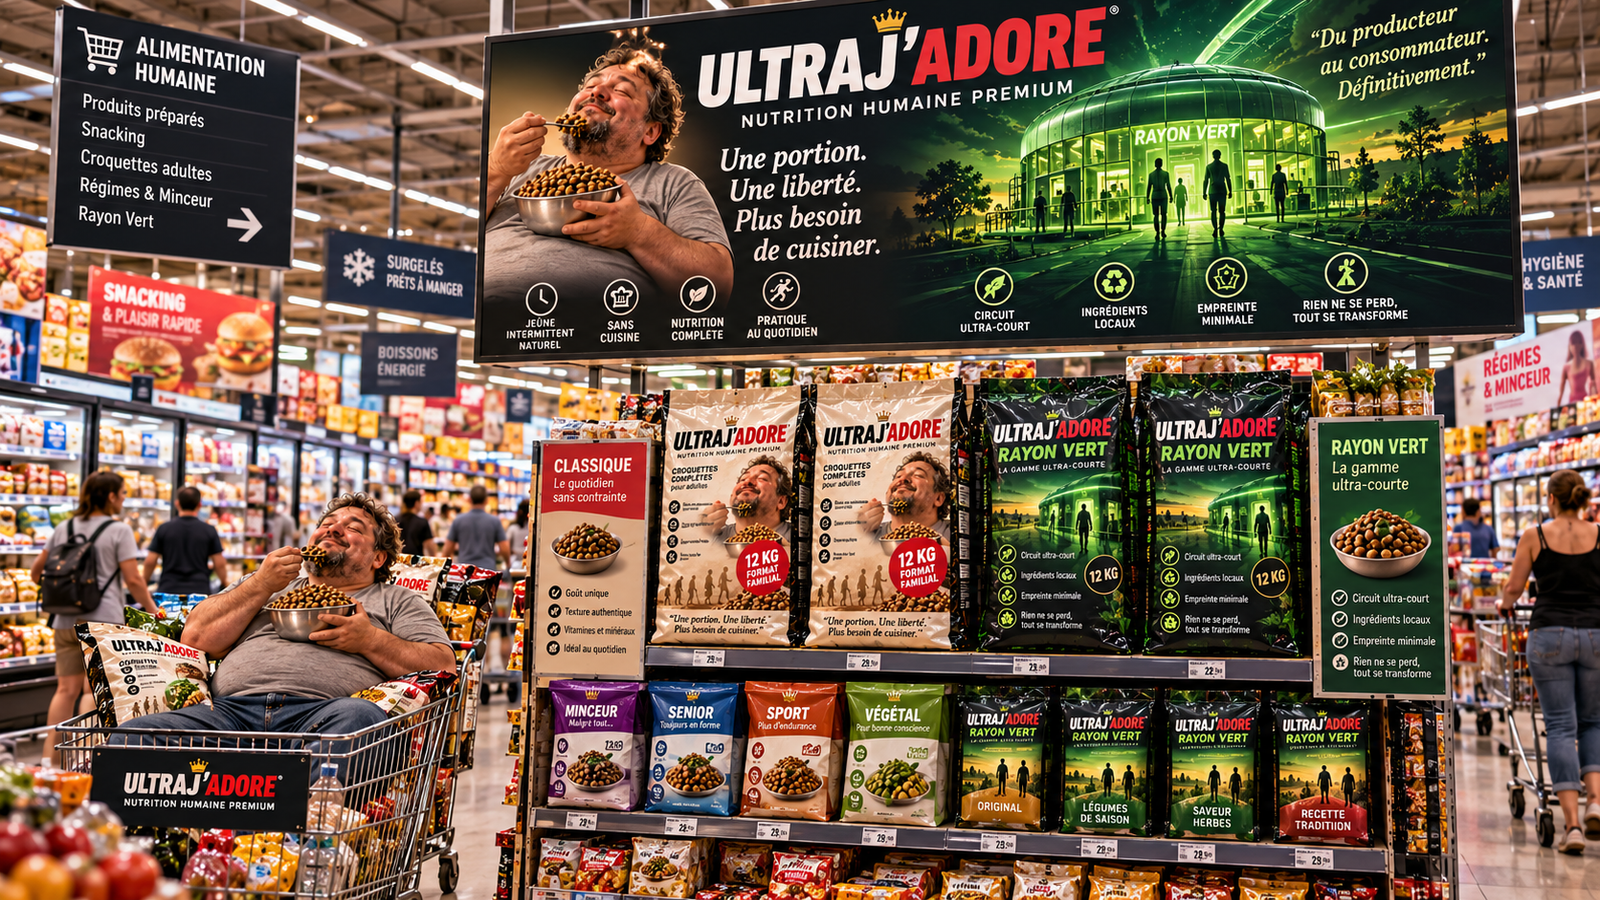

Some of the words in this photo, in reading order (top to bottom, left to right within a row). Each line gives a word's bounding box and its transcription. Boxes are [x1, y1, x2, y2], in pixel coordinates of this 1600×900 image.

[1351, 6, 1458, 48] producteur
[136, 36, 266, 78] ALIMENTATION
[1320, 58, 1343, 76] au
[1348, 29, 1489, 70] consommateur.
[135, 62, 217, 94] HUMAINE
[82, 93, 141, 117] Produits
[145, 106, 205, 128] préparés
[741, 104, 853, 129] NUTRITION
[863, 91, 961, 116] HUMAINE
[972, 80, 1074, 105] PREMIUM
[81, 121, 146, 148] Snacking
[1134, 124, 1190, 146] RAYON
[1195, 123, 1240, 139] VERT
[720, 147, 767, 172] Une
[772, 139, 867, 174] portion.
[80, 149, 159, 174] Croquettes
[162, 162, 213, 182] adultes
[730, 178, 776, 202] Une
[782, 169, 862, 198] liberté.
[80, 177, 140, 199] Régimes
[144, 185, 155, 200] &
[159, 186, 214, 209] Minceur
[78, 205, 122, 226] Rayon
[126, 210, 154, 229] Vert
[734, 207, 783, 232] Plus
[789, 201, 862, 228] besoin
[754, 238, 780, 262] de
[786, 233, 880, 260] cuisiner.
[386, 254, 444, 276] SURGELÉS
[1522, 252, 1585, 272] HYGIÈNE
[1522, 276, 1534, 290] &
[1537, 270, 1584, 290] SANTÉ
[426, 280, 463, 298] MANGER
[104, 282, 186, 313] SNACKING
[1302, 300, 1328, 310] RIEN
[1330, 299, 1346, 309] NE
[1348, 298, 1362, 308] SE
[1366, 298, 1398, 309] PERD,
[974, 310, 1015, 320] CIRCUIT
[1081, 304, 1148, 317] INGRÉDIENTS
[1197, 302, 1258, 314] EMPREINTE
[102, 306, 113, 322] &
[114, 307, 160, 329] PLAISIR
[162, 314, 203, 335] RAPIDE
[525, 316, 556, 328] JEÛNE
[671, 316, 724, 328] NUTRITION
[757, 314, 807, 326] PRATIQUE
[1202, 314, 1254, 326] MINIMALE
[1292, 312, 1320, 323] TOUT
[1322, 312, 1336, 322] SE
[1338, 309, 1409, 322] TRANSFORME
[607, 320, 634, 330] SANS
[960, 321, 1030, 333] ULTRA-COURT
[1094, 318, 1136, 330] LOCAUX
[506, 328, 575, 339] INTERMITTENT
[600, 332, 640, 343] CUISINE
[746, 328, 761, 339] AU
[764, 327, 818, 340] QUOTIDIEN
[378, 345, 438, 361] BOISSONS
[518, 340, 562, 352] NATUREL
[1484, 345, 1542, 378] RÉGIMES
[377, 361, 426, 377] ÉNERGIE
[1484, 381, 1492, 398] &
[1494, 366, 1551, 396] MINCEUR
[998, 444, 1058, 462] RAYON
[1062, 441, 1108, 458] VERT
[1160, 444, 1222, 462] RAYON
[1227, 442, 1274, 458] VERT
[1331, 438, 1384, 456] RAYON
[1388, 438, 1429, 454] VERT
[554, 457, 632, 474] CLASSIQUE
[1332, 461, 1347, 474] La
[1351, 462, 1400, 477] gamme
[554, 478, 566, 489] Le
[1332, 478, 1410, 492] ultra-courte
[552, 494, 575, 502] sans
[577, 491, 627, 502] contrainte
[744, 552, 761, 568] 12
[762, 548, 779, 564] KG
[898, 551, 914, 568] 12
[917, 546, 936, 564] KG
[746, 564, 778, 578] FORMAT
[900, 564, 936, 579] FORMAT
[1089, 570, 1103, 584] 12
[1104, 566, 1118, 580] KG
[1256, 572, 1270, 586] 12
[1270, 568, 1286, 584] KG
[746, 574, 781, 588] FAMILIAL
[900, 574, 940, 588] FAMILIAL
[584, 590, 610, 600] unique
[1352, 593, 1380, 603] Circuit
[1382, 593, 1430, 603] ultra-court
[564, 608, 590, 617] Texture
[592, 608, 633, 619] authentique
[1353, 614, 1400, 626] Ingrédients
[1402, 614, 1431, 624] locaux
[564, 625, 596, 636] Vitamines
[597, 626, 604, 636] et
[1353, 635, 1396, 648] Empreinte
[1397, 636, 1436, 646] minimale
[564, 643, 581, 654] Idéal
[582, 646, 592, 654] au
[592, 644, 627, 656] quotidien
[1353, 656, 1372, 666] Rien
[1398, 657, 1420, 669] perd,
[1353, 668, 1371, 678] tout
[1372, 670, 1383, 678] se
[1385, 668, 1432, 678] transforme
[564, 704, 618, 718] MINCEUR
[668, 705, 714, 720] SENIOR
[766, 706, 811, 720] SPORT
[865, 704, 922, 722] VÉGÉTAL
[970, 728, 1006, 737] RAYON
[1008, 728, 1037, 737] VERT
[1072, 731, 1109, 742] RAYON
[1112, 731, 1142, 740] VERT
[1178, 734, 1216, 744] RAYON
[1219, 733, 1249, 742] VERT
[1286, 733, 1325, 744] RAYON
[1328, 732, 1360, 742] VERT
[124, 798, 177, 808] NUTRITION
[180, 800, 226, 810] HUMAINE
[229, 802, 275, 811] PREMIUM
[977, 802, 1022, 813] ORIGINAL
[1082, 801, 1128, 813] LÉGUMES
[1192, 806, 1232, 816] SAVEUR
[1080, 814, 1092, 823] DE
[1095, 814, 1130, 824] SAISON
[1301, 809, 1346, 820] RECETTE
[1193, 818, 1232, 828] HERBES
